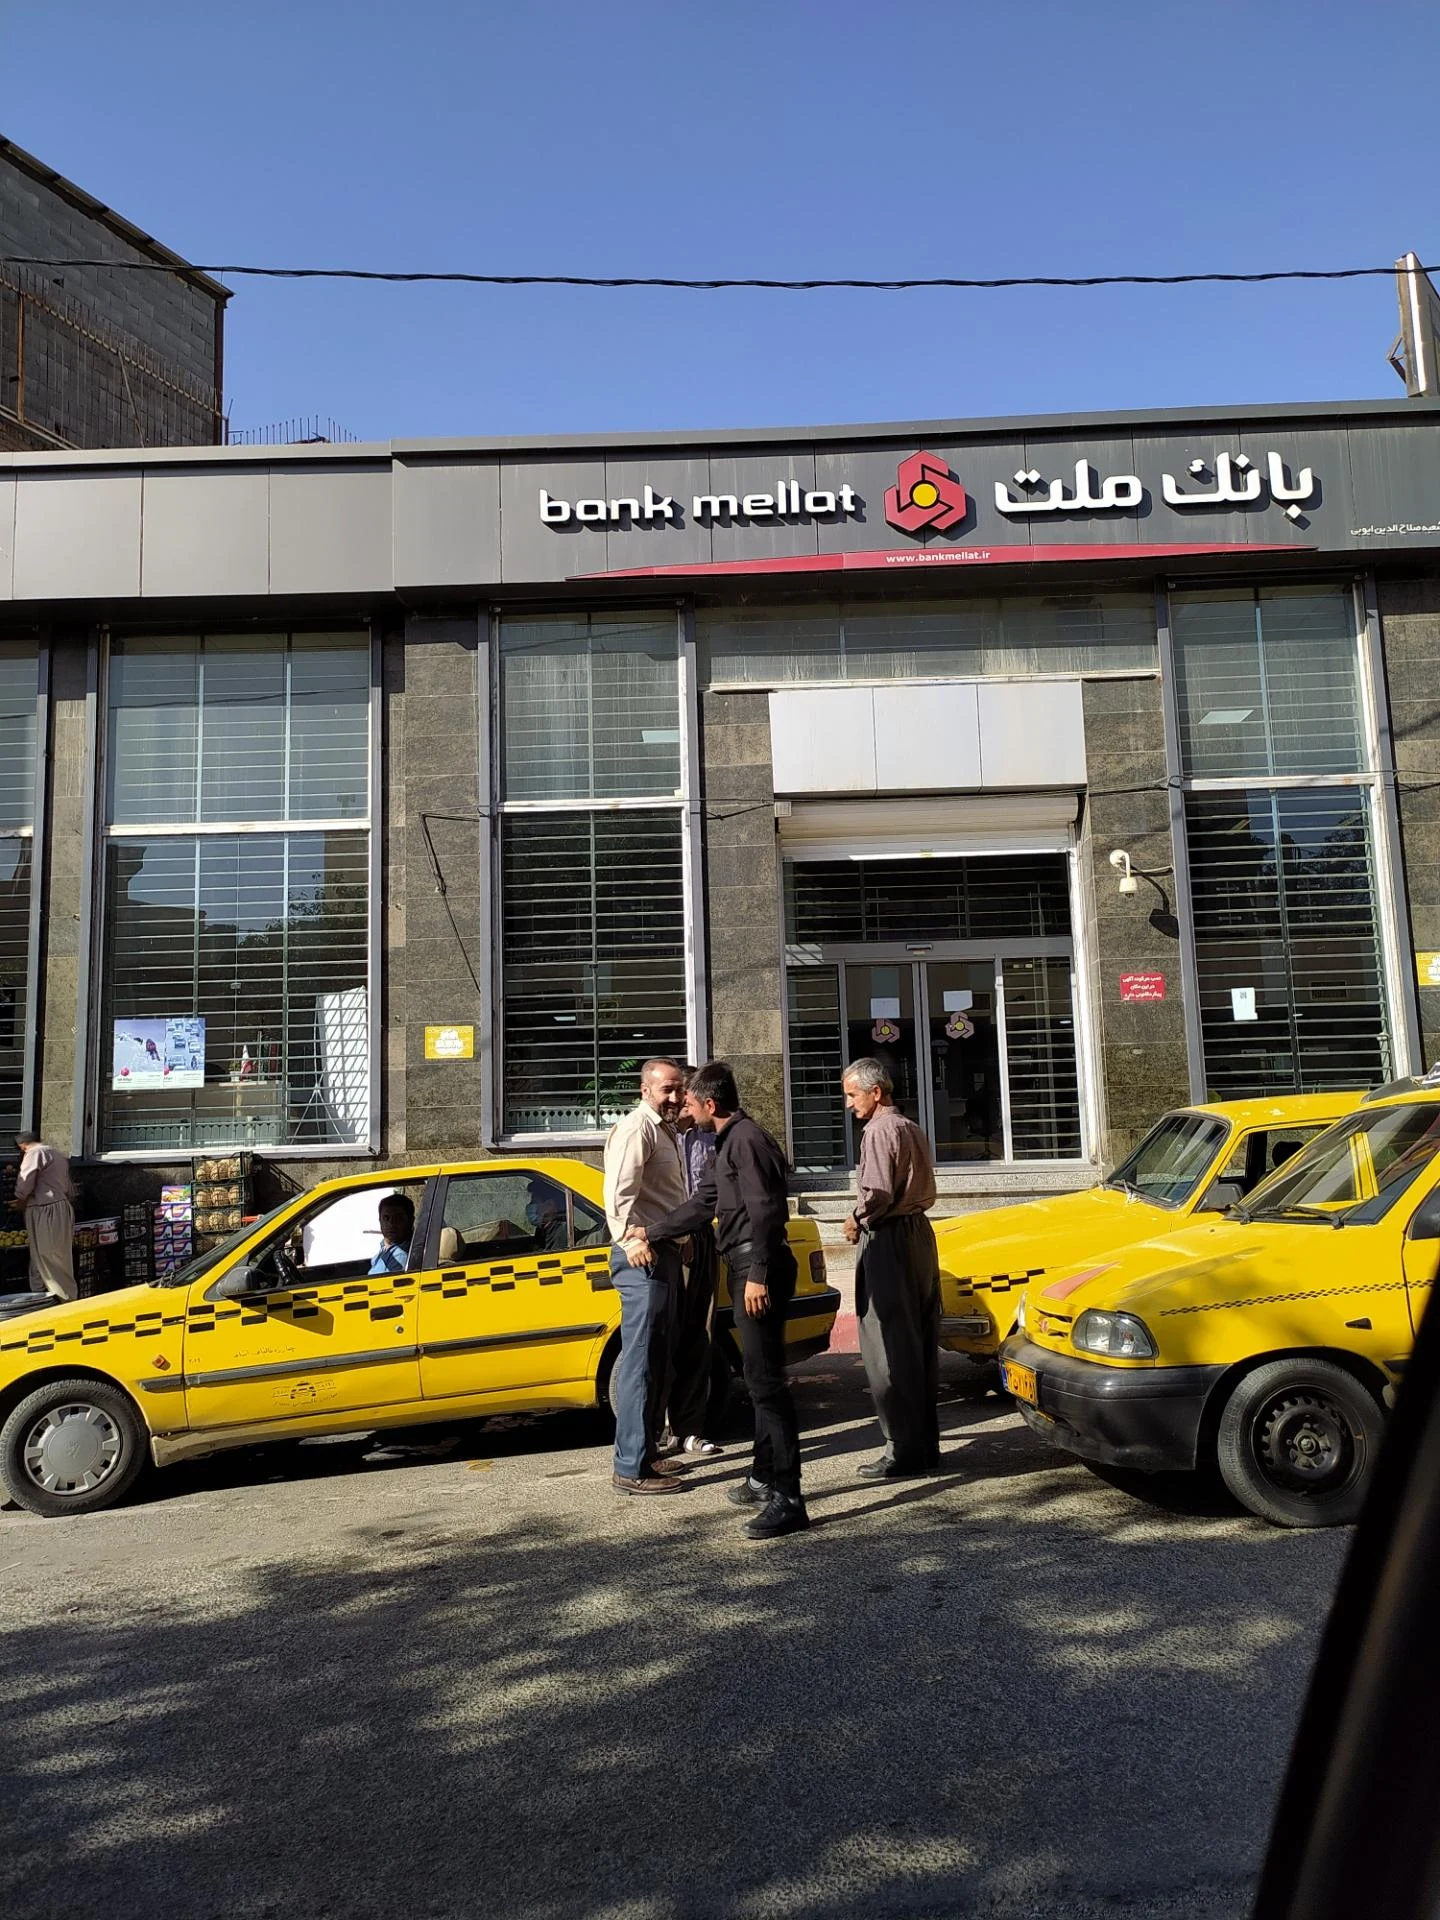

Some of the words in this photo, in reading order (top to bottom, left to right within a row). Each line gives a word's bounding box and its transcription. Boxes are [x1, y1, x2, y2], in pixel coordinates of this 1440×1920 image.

[994, 458, 1143, 513] ملت
[539, 484, 673, 522] bank
[693, 479, 856, 518] mellat
[1399, 523, 1421, 534] صلاح
[886, 550, 991, 563] www.bankmellat.ir
